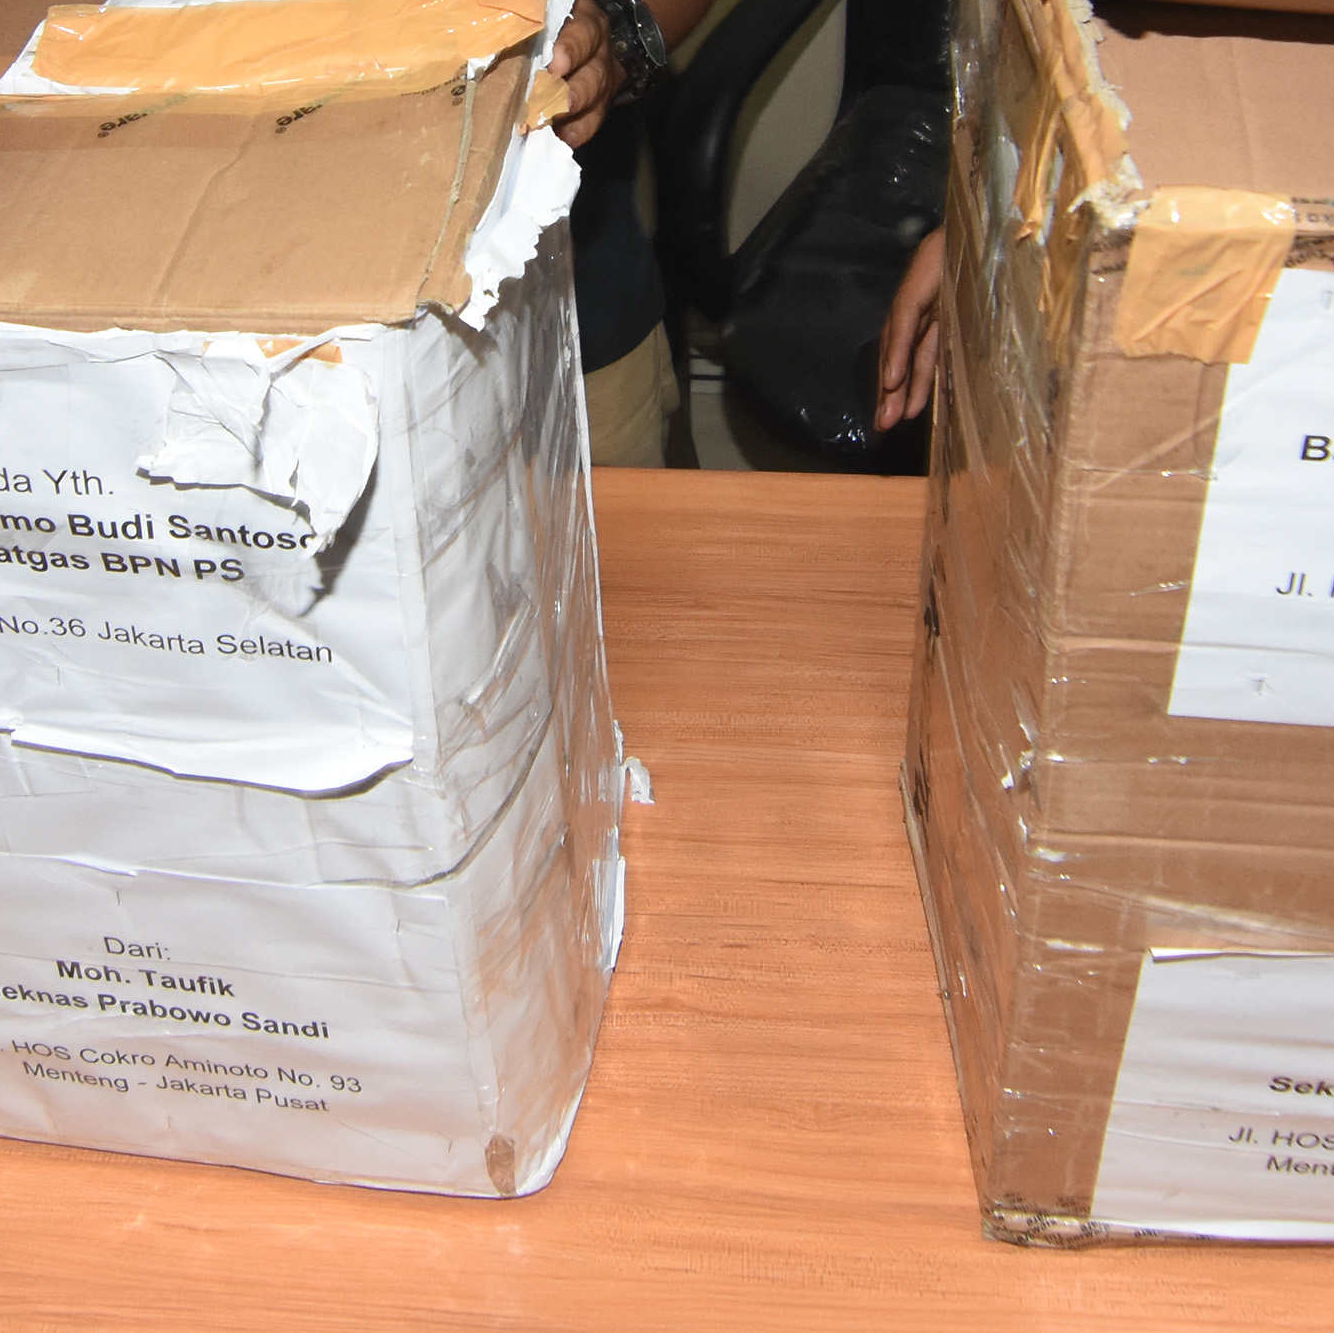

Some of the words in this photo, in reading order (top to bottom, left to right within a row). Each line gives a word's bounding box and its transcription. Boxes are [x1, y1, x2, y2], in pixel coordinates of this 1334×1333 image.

[43, 468, 115, 498] Yth.
[67, 511, 155, 543] Budi
[100, 550, 181, 581] BPN
[193, 555, 246, 583] PS
[1275, 570, 1315, 601] Jl.
[96, 619, 207, 657] Jakarta
[216, 632, 334, 664] Selatan
[103, 935, 172, 962] Dari:
[56, 959, 132, 985] Moh.
[138, 967, 237, 999] Taufik
[98, 992, 233, 1029] Prabowo
[240, 1010, 332, 1041] Sandi
[10, 1039, 73, 1062] HOS
[79, 1047, 157, 1069] Cokro
[164, 1053, 270, 1082] Aminoto
[276, 1065, 322, 1090] No.
[329, 1070, 364, 1095] 93
[21, 1059, 130, 1094] Menteng
[153, 1074, 248, 1103] Jakarta
[255, 1086, 332, 1114] Pusat
[1227, 1125, 1260, 1147] Jl.
